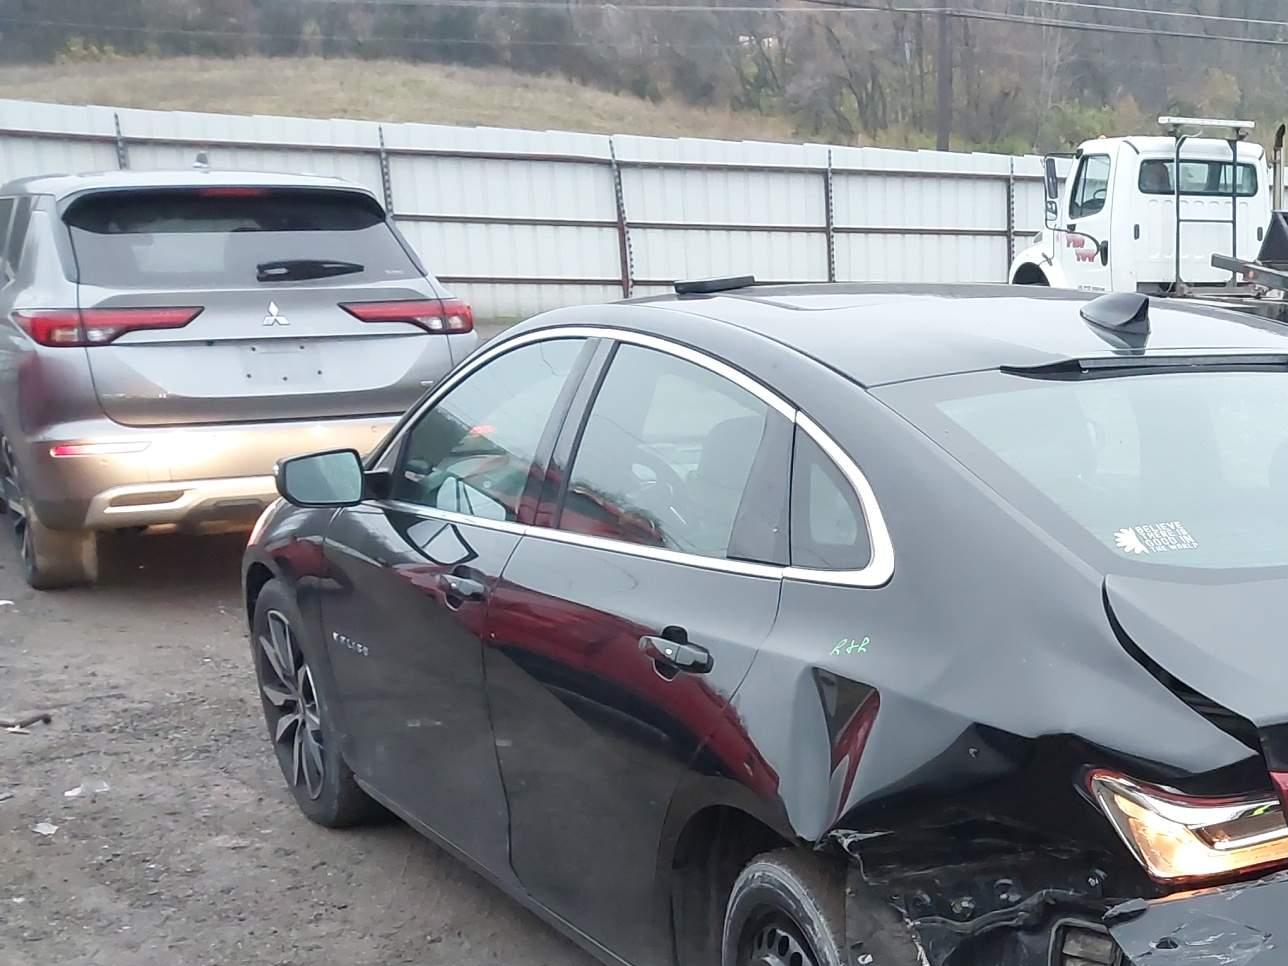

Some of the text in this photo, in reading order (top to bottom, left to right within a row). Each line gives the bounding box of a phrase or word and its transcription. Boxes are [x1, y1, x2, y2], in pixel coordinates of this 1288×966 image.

[1135, 521, 1183, 533] BELIEVE
[1143, 528, 1176, 540] THERE
[1145, 535, 1195, 547] GOOD IN
